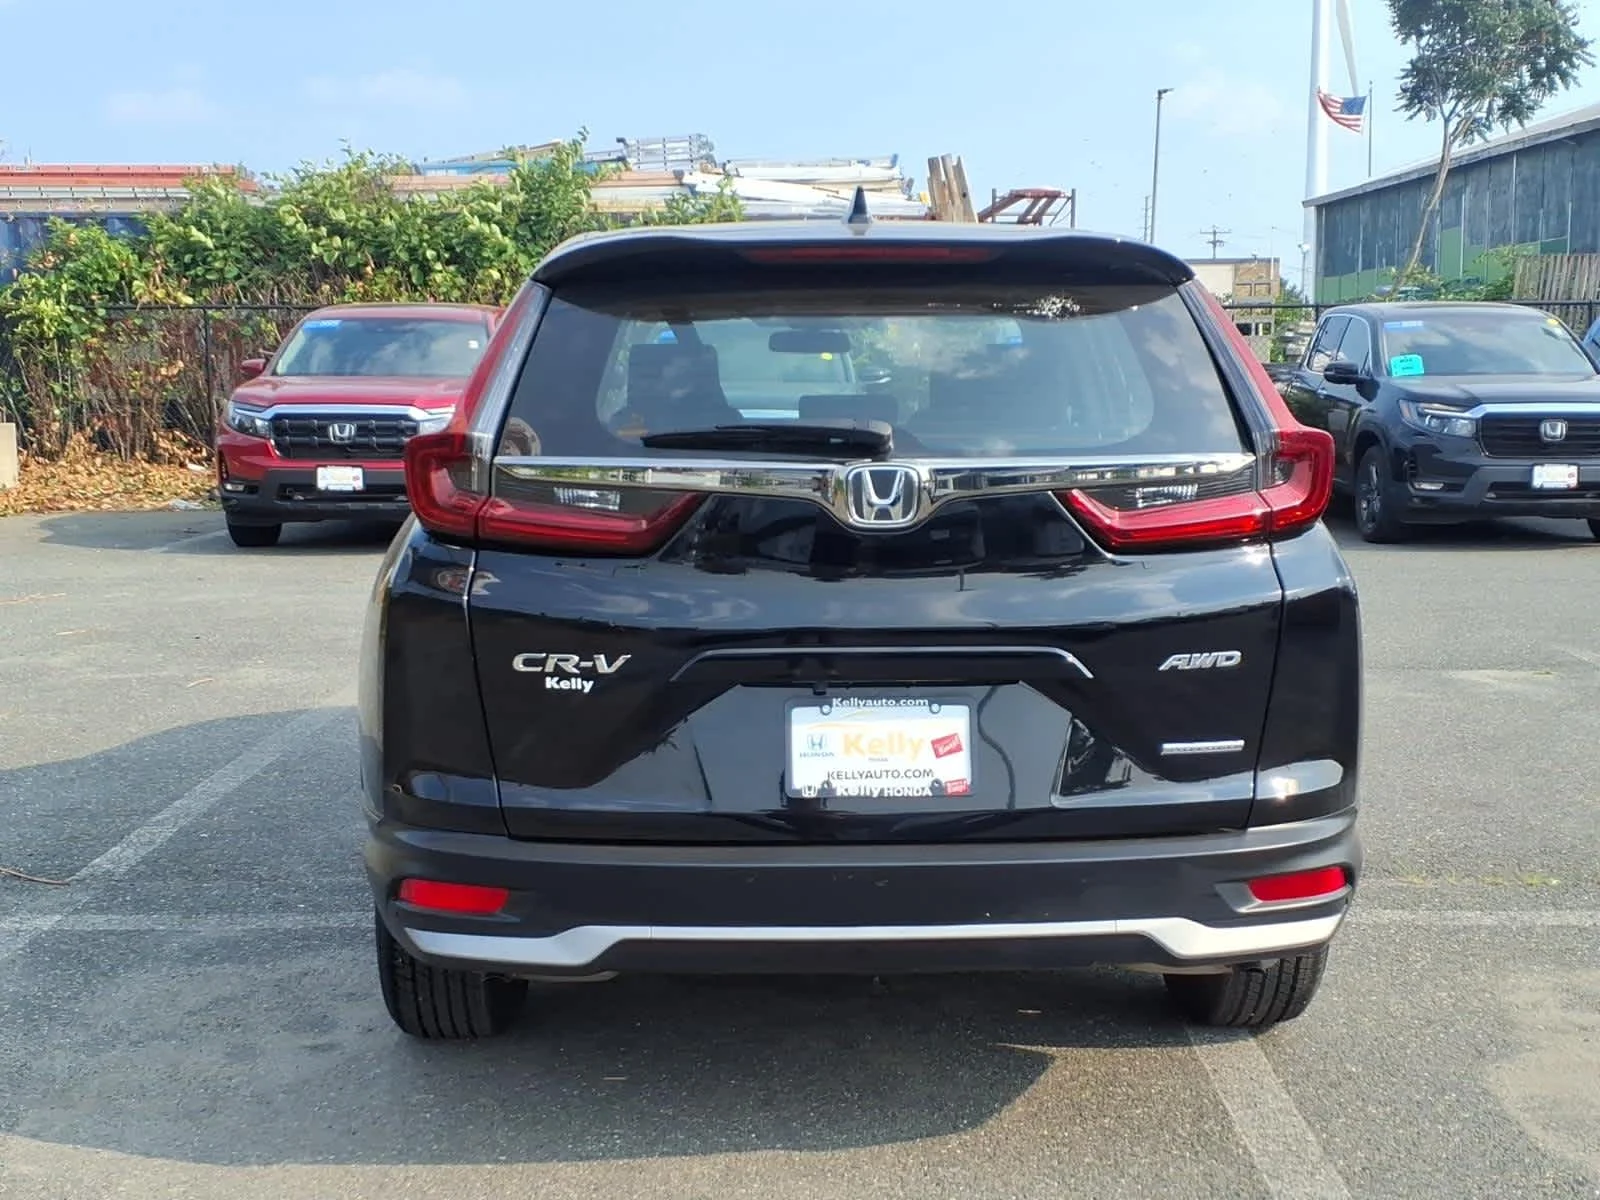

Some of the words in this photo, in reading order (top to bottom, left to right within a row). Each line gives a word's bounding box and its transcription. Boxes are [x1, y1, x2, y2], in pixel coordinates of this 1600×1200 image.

[512, 653, 632, 673] CR-V
[1158, 650, 1242, 671] AWD
[545, 676, 594, 693] Kelly
[832, 698, 929, 708] Kellyauto.com
[844, 732, 924, 760] Kelly
[827, 769, 934, 780] KELLYAUTO.COM
[836, 784, 881, 797] Kelly
[883, 787, 932, 797] HONDA
